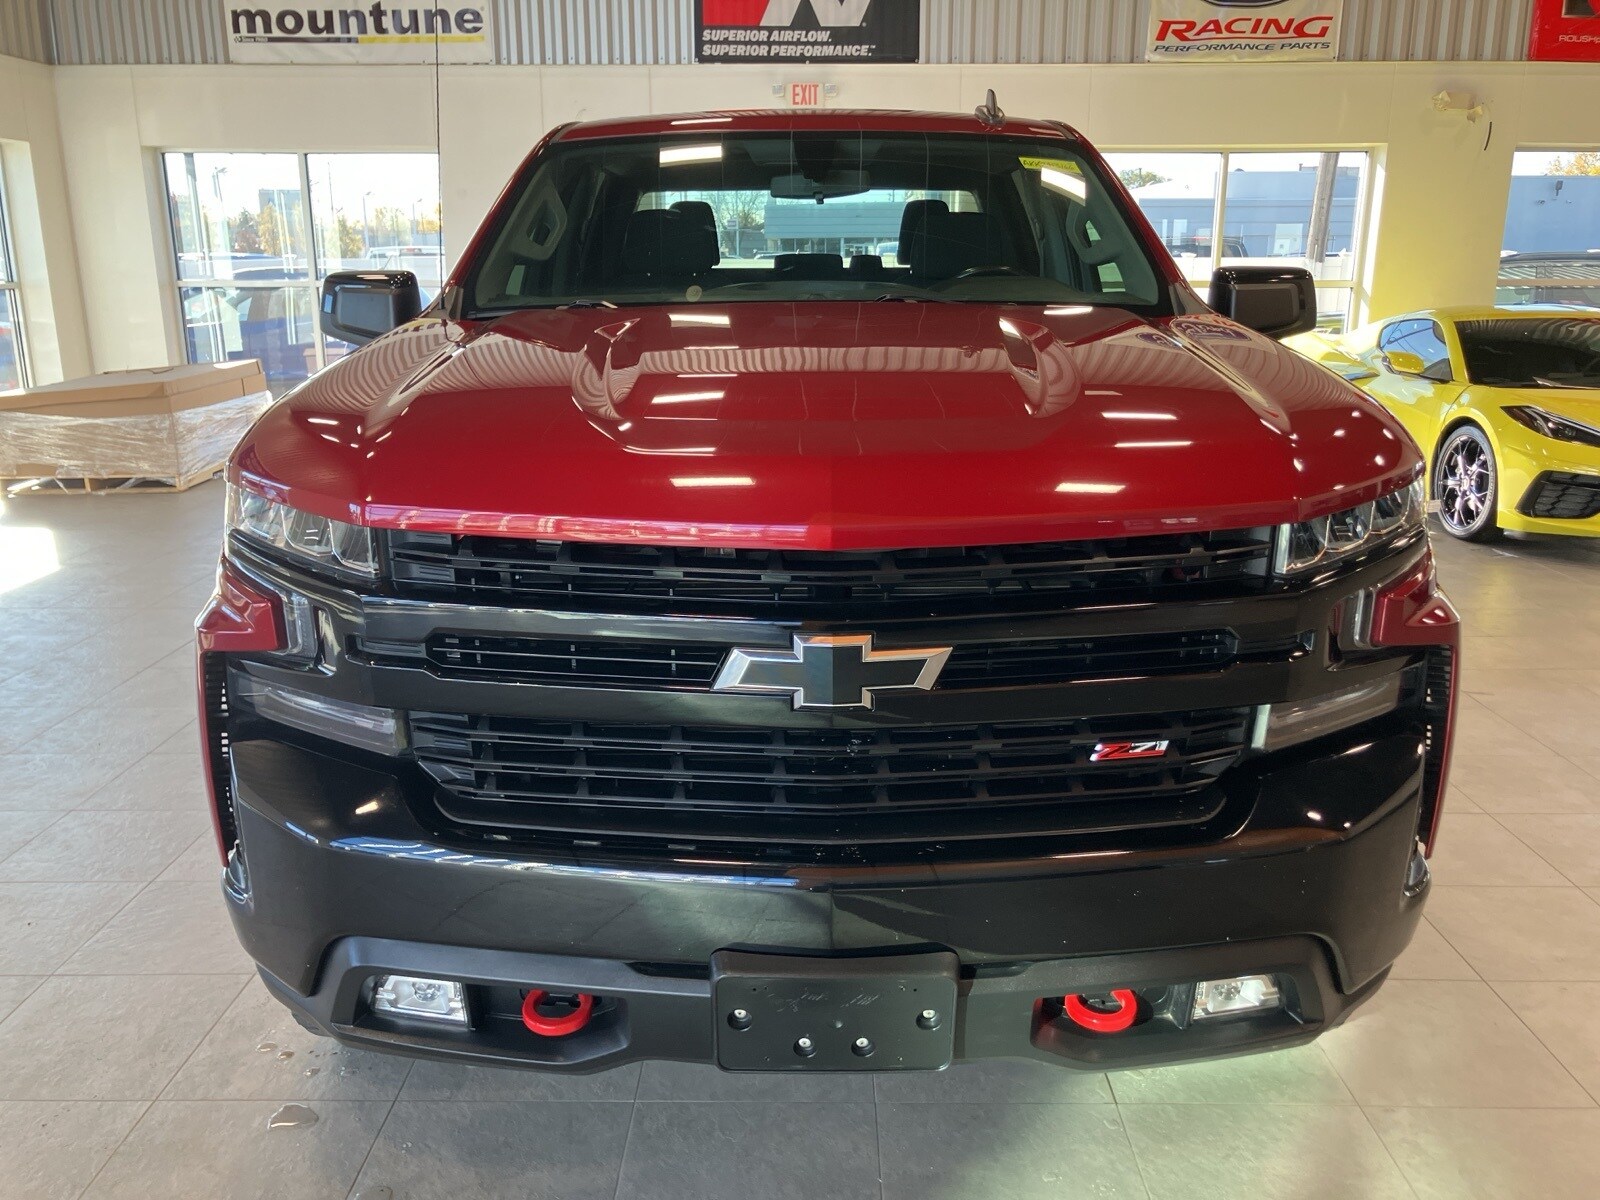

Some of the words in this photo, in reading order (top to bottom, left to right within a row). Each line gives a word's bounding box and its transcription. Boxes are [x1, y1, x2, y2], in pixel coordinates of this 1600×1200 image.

[231, 1, 483, 34] mountune
[702, 29, 768, 42] SUPERIOR
[770, 30, 832, 42] AIRFLOW.
[1155, 16, 1334, 42] RACING
[702, 44, 768, 56] SUPERIOR
[1154, 43, 1275, 53] PERFORMANCE
[1280, 42, 1331, 50] PARTS
[792, 84, 819, 105] EXIT
[1089, 740, 1169, 761] Z71
